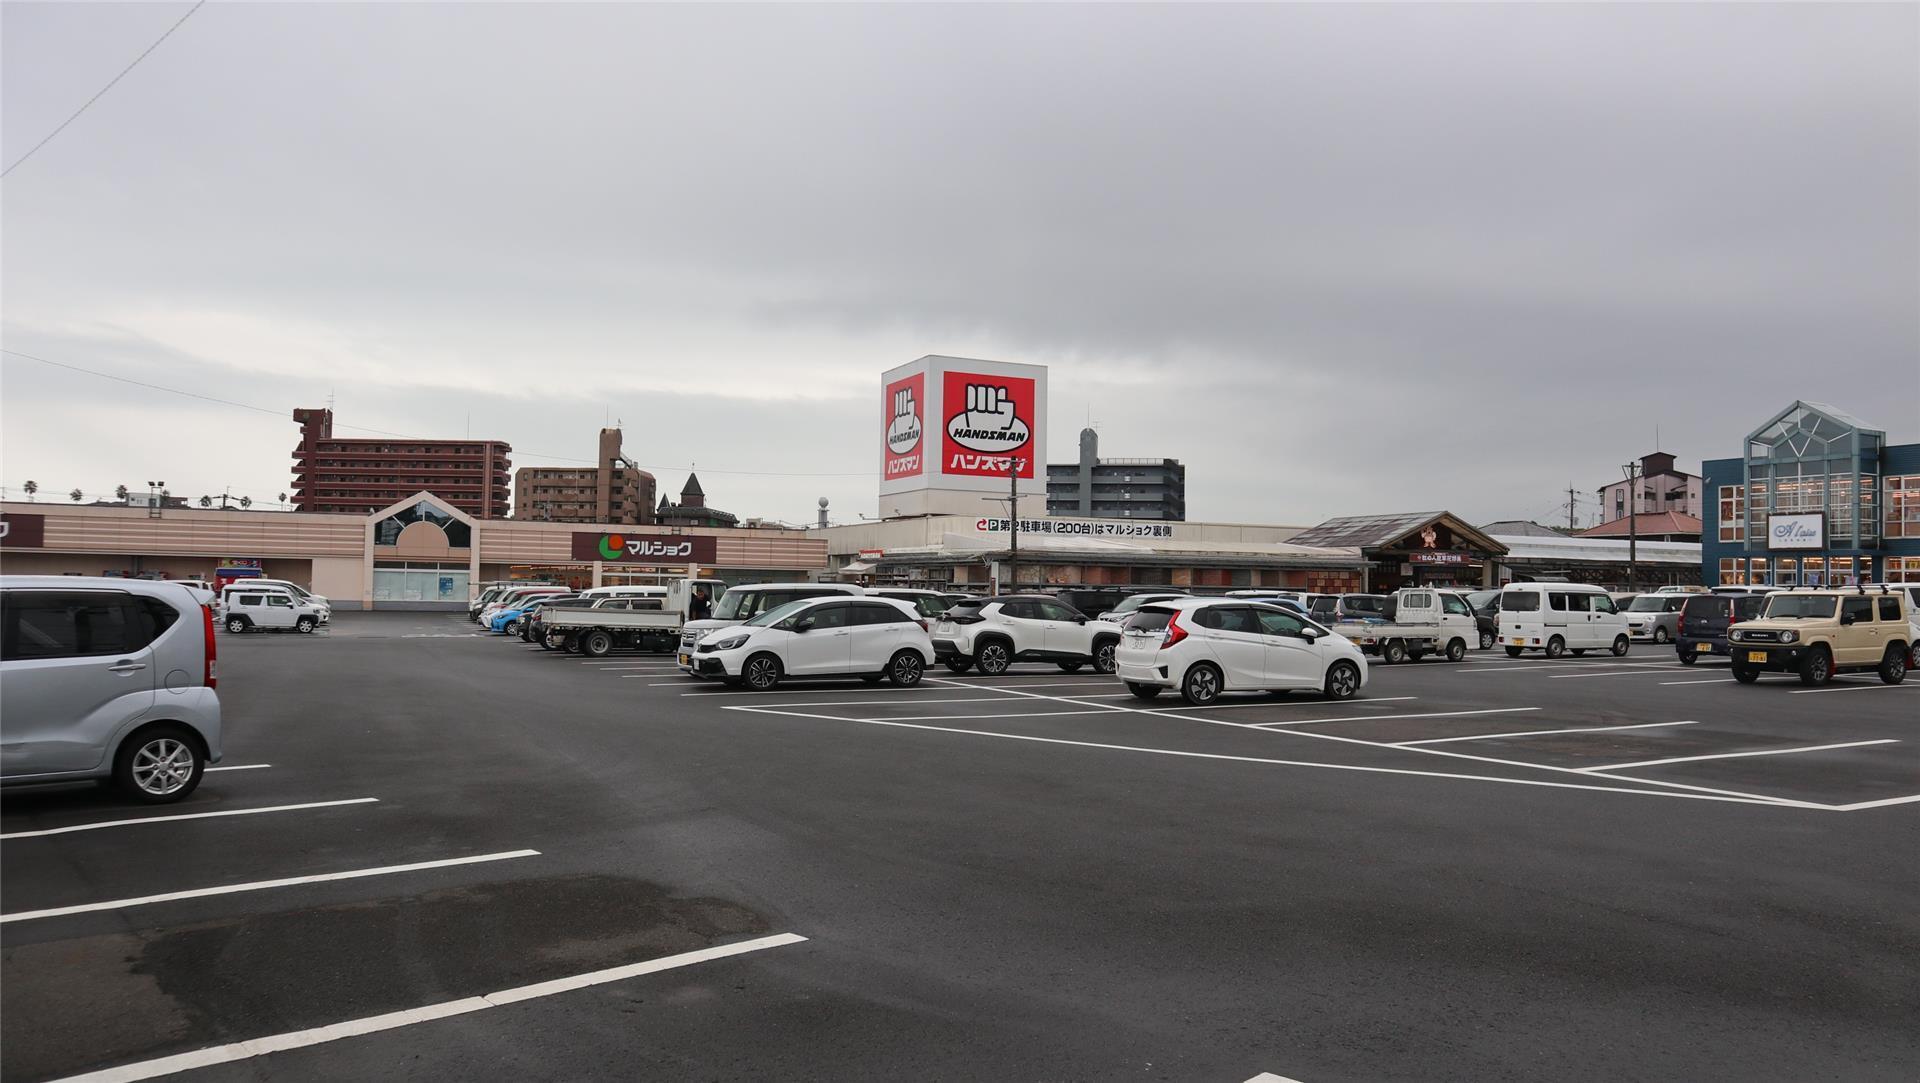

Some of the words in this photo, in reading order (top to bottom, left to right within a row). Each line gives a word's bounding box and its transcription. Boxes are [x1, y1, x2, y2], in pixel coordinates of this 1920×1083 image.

[889, 428, 920, 446] HANDSMAN
[953, 428, 1026, 442] HANDSMAN
[887, 454, 920, 474] ハンズマン
[626, 541, 692, 556] マルショク
